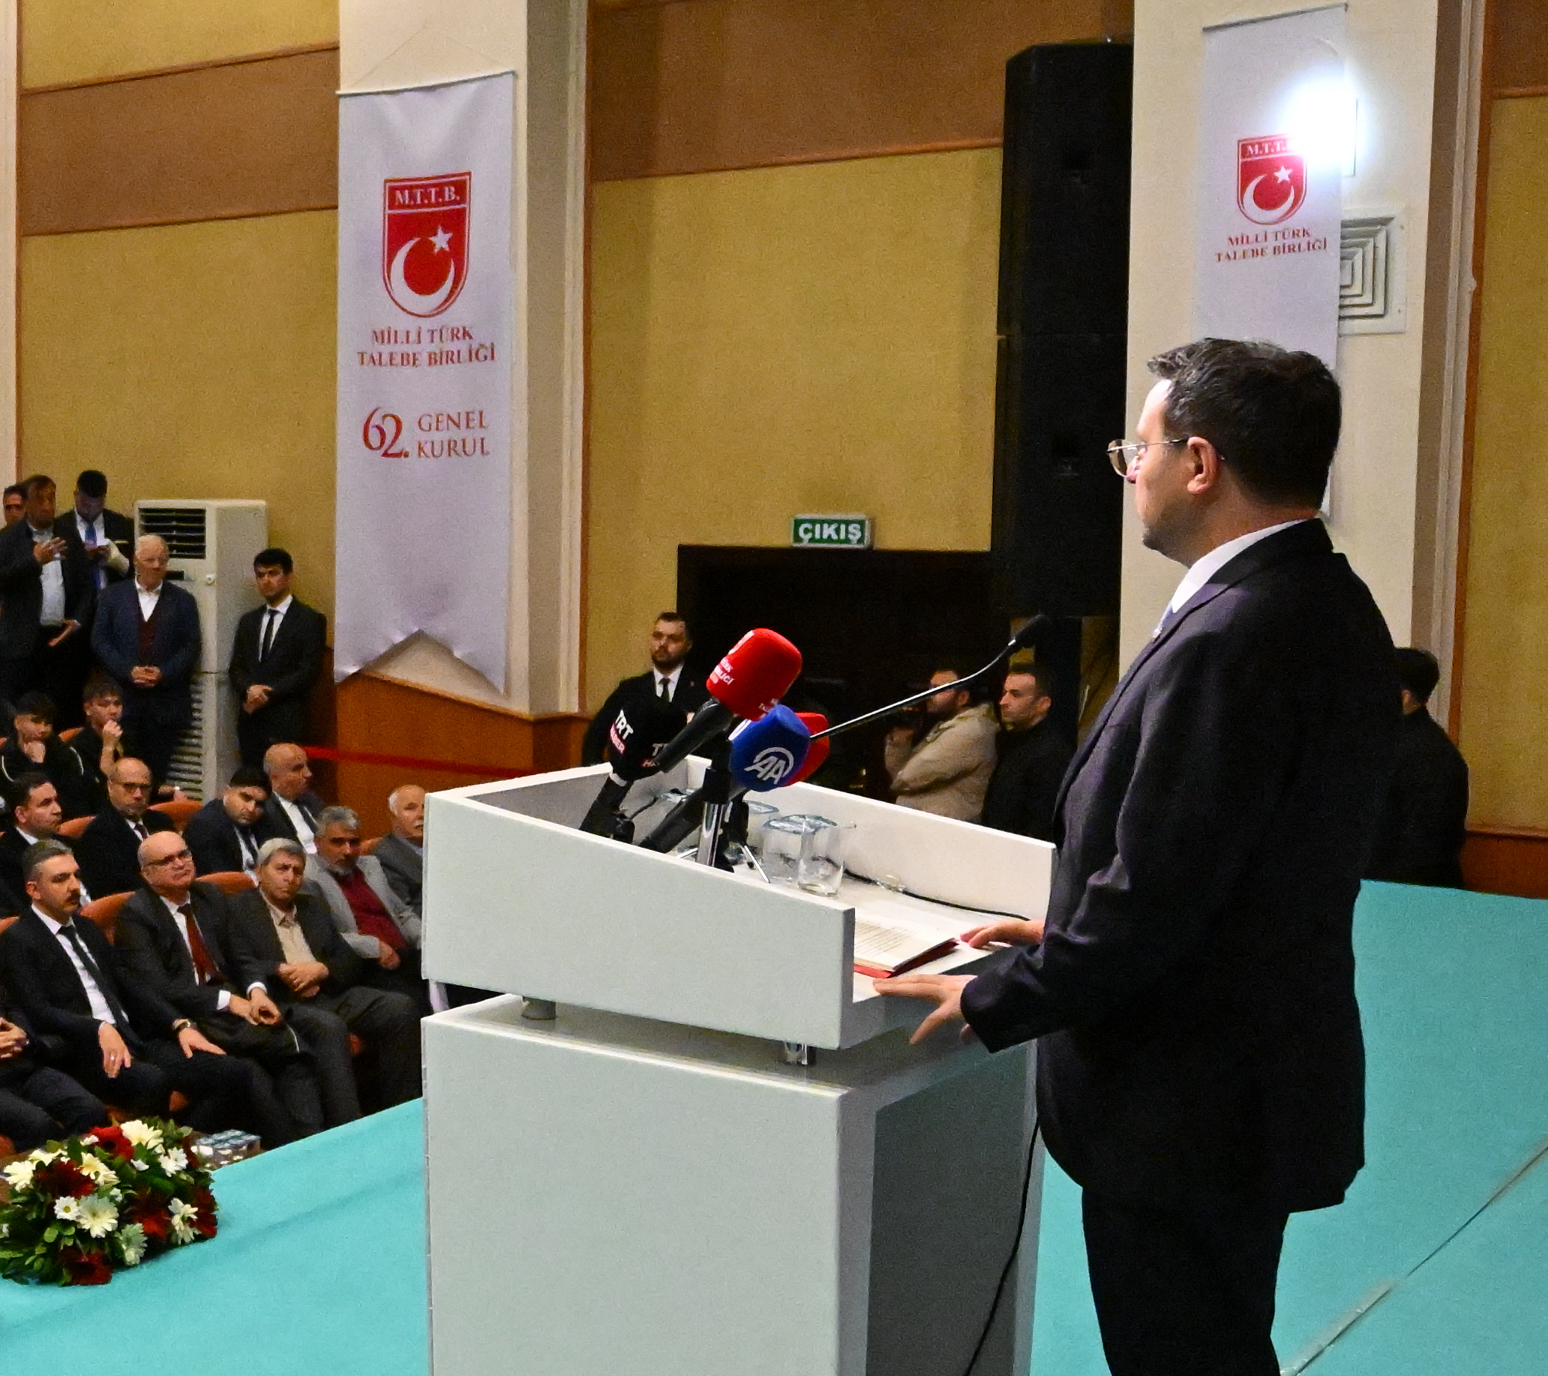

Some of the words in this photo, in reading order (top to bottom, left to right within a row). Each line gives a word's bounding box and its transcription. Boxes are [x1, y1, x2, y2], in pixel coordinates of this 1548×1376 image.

[1246, 140, 1290, 156] M.T.T.
[394, 186, 460, 206] M.T.T.B.
[1228, 230, 1268, 246] MİLLİ
[1273, 227, 1311, 242] TÜRK
[1216, 246, 1268, 262] TALEBE
[1273, 237, 1327, 255] BİRLİĞİ
[372, 326, 422, 345] MİLLİ
[427, 325, 474, 344] TÜRK
[357, 351, 422, 368] TALEBE
[426, 342, 496, 367] BİRLİĞİ
[417, 410, 490, 432] GENEL
[417, 437, 490, 459] KURUL
[798, 522, 862, 544] ÇIKIŞ
[615, 709, 634, 740] TRT
